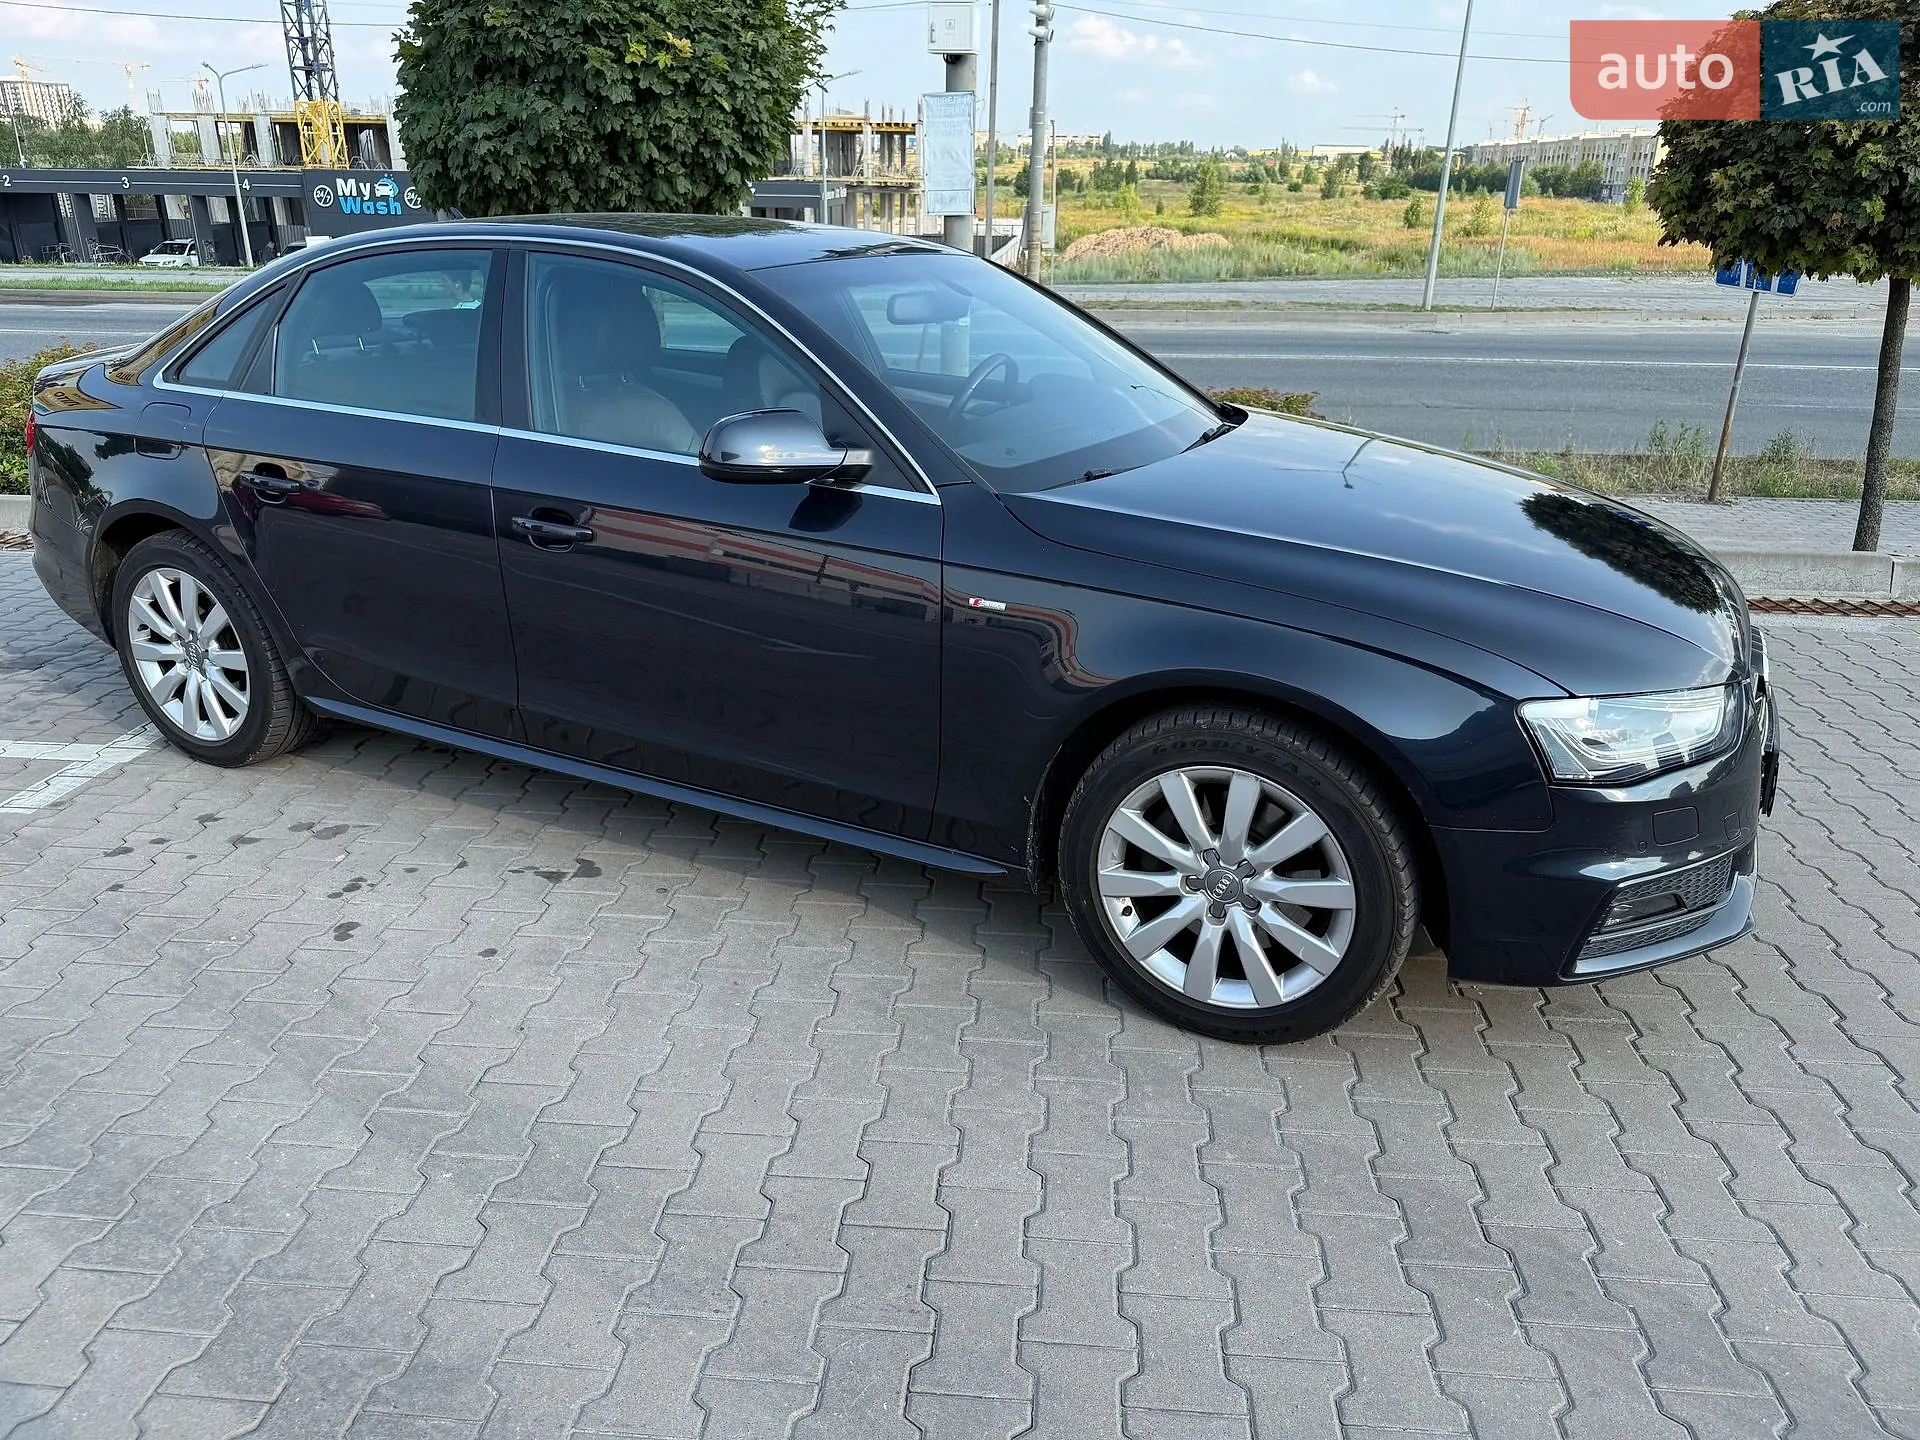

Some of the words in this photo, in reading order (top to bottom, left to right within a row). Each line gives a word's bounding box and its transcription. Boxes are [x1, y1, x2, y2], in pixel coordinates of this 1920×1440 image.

[2, 175, 12, 187] 2
[121, 176, 130, 189] 3
[241, 178, 250, 190] 4
[315, 188, 332, 206] 24/7
[336, 178, 371, 201] My
[339, 196, 402, 215] Wash
